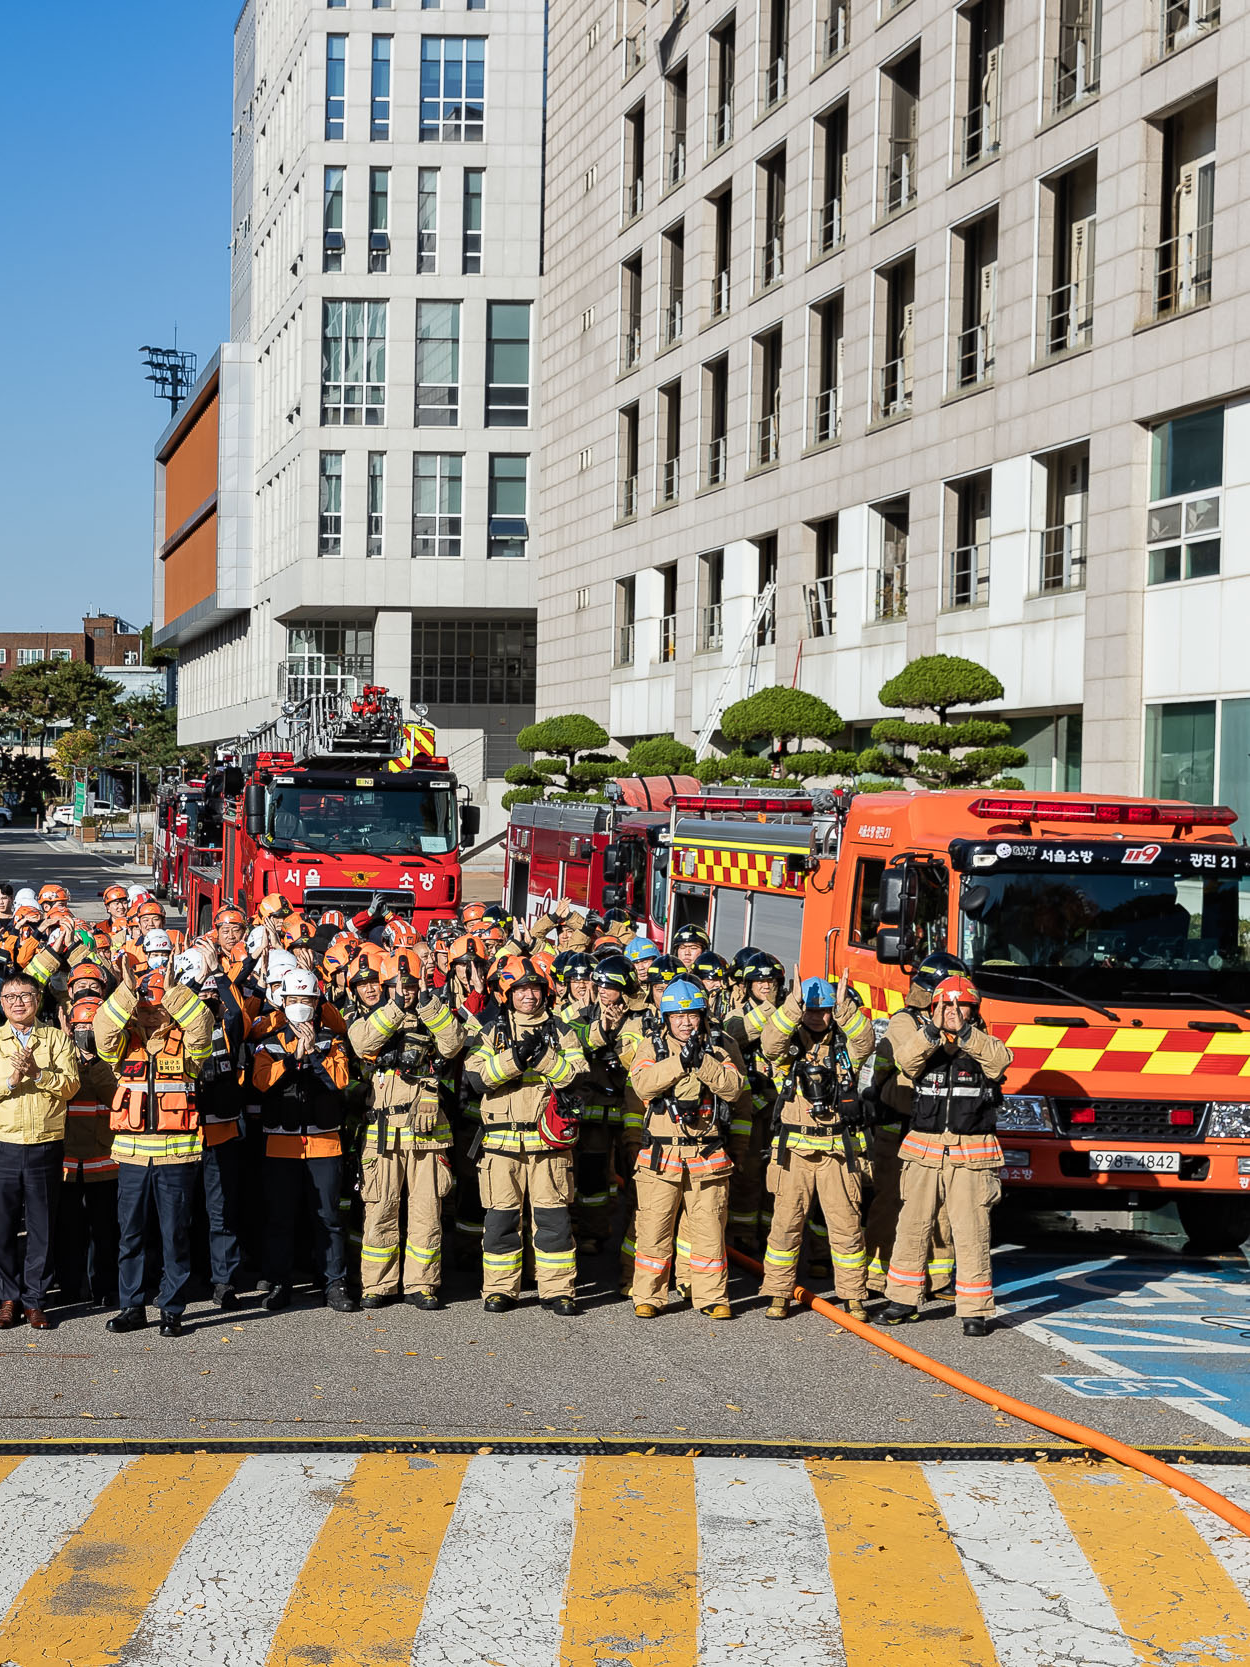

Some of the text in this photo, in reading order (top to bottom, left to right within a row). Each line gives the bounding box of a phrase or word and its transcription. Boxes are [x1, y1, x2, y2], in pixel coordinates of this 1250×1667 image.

[1040, 849, 1094, 864] 서울소방
[1121, 844, 1162, 865] 119
[1189, 853, 1238, 868] 광진 21
[284, 868, 436, 892] 서울 소방
[123, 1061, 143, 1074] 119
[1000, 1168, 1033, 1180] 울소방
